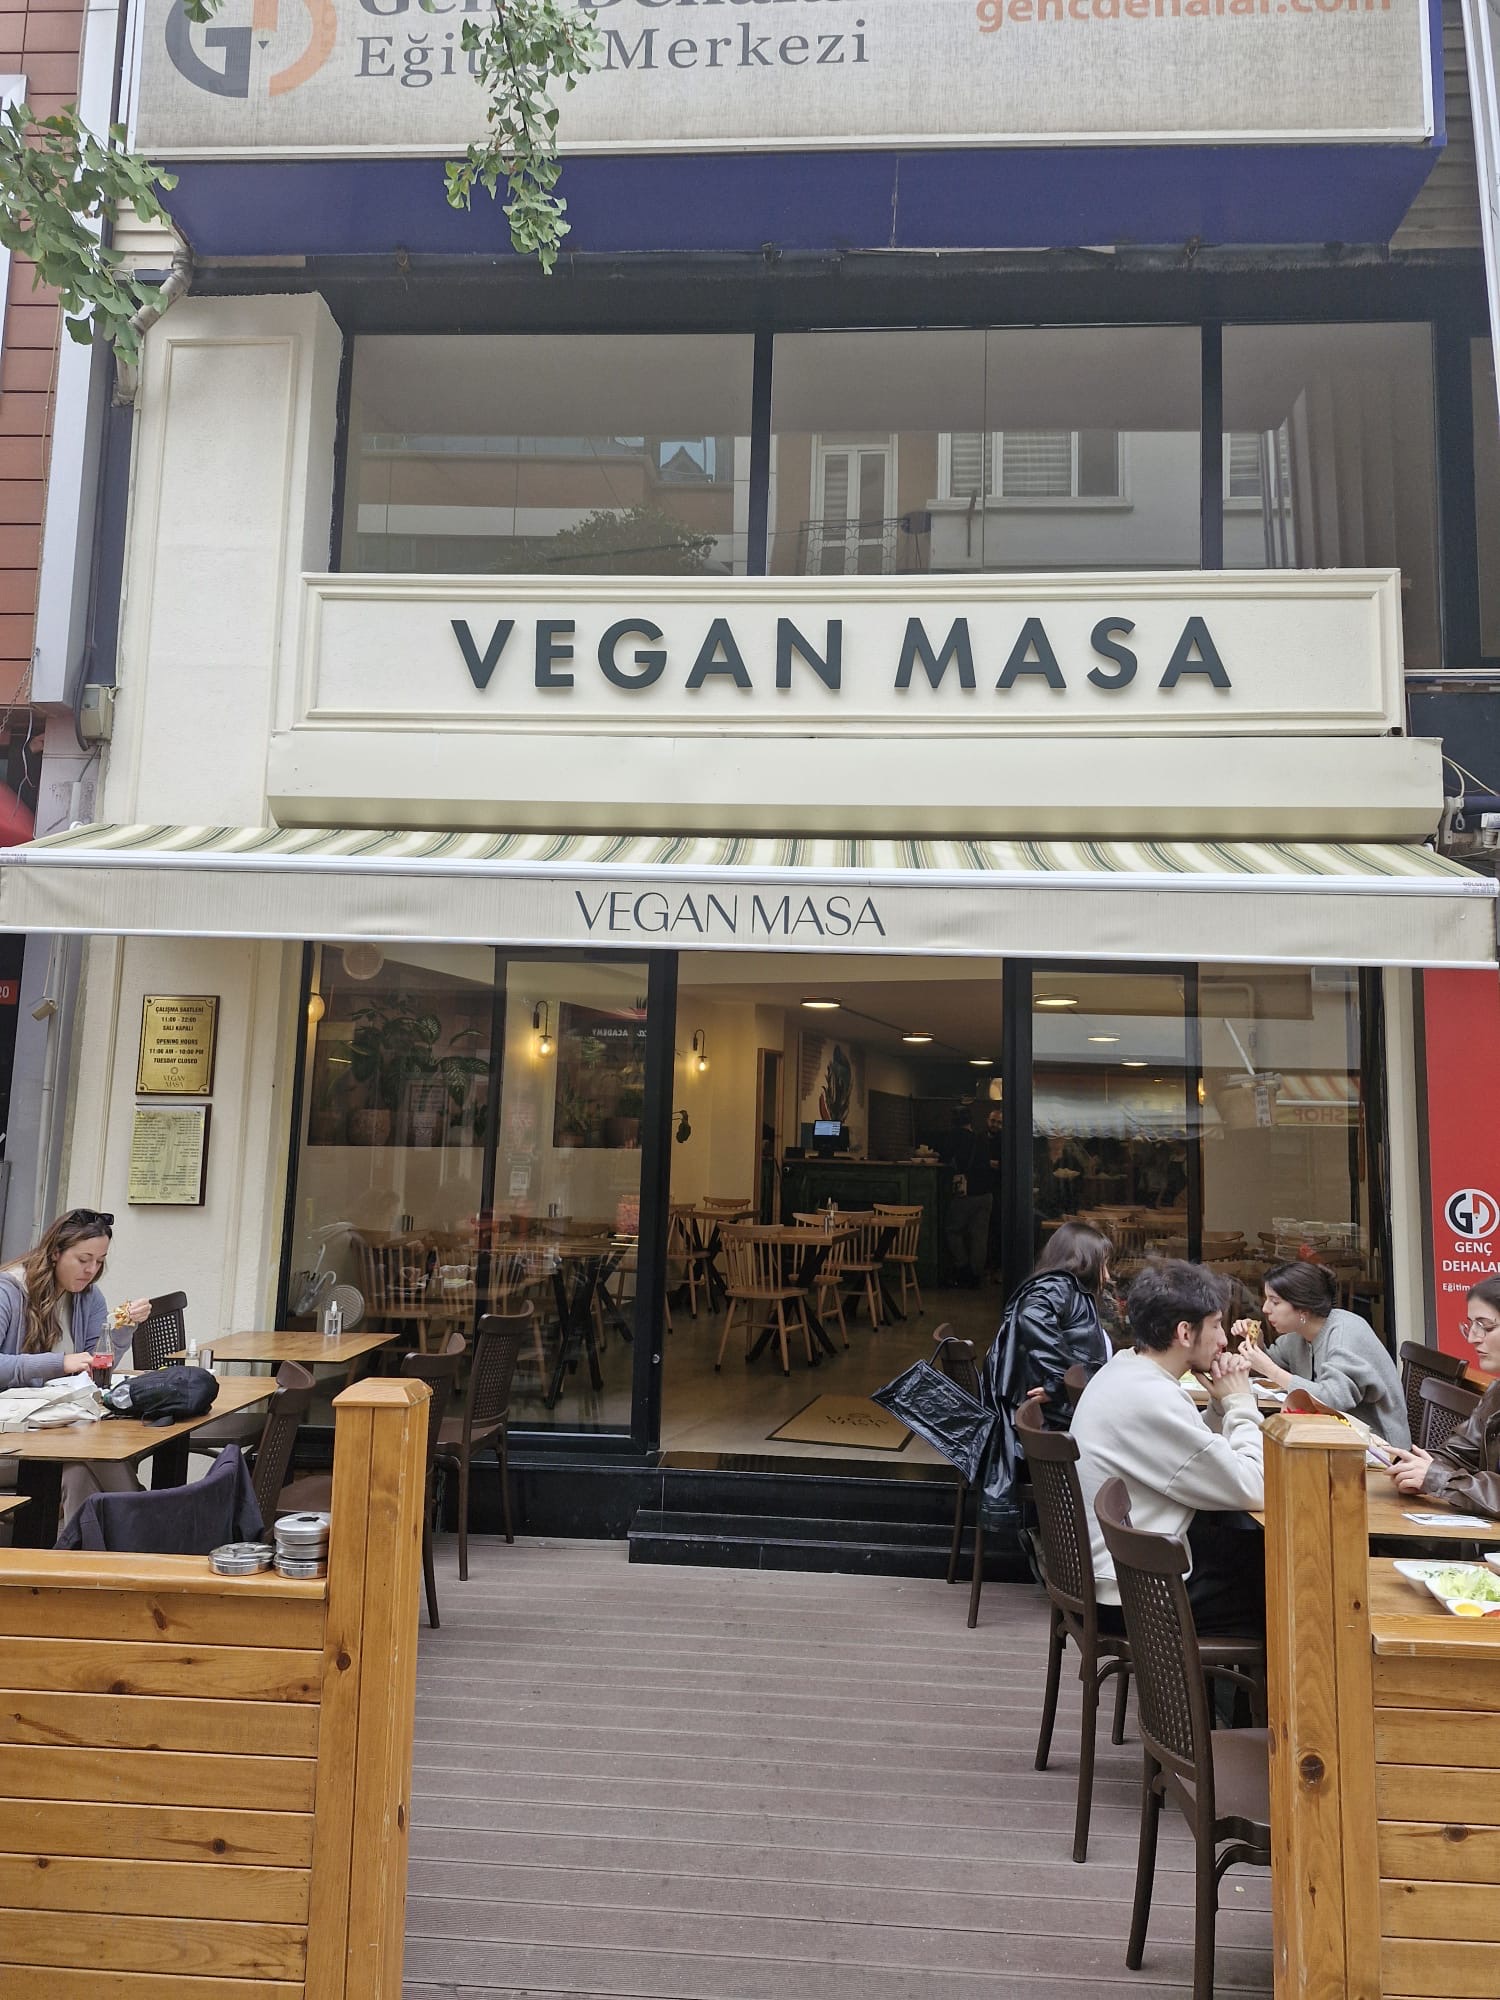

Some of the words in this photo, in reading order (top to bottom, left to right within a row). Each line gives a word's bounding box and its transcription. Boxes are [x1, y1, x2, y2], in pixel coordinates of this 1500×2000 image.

[354, 32, 560, 88] Eğit
[601, 19, 869, 71] Merkezi
[451, 617, 842, 691] VEGAN
[893, 616, 1232, 690] MASA
[575, 890, 738, 934] VEGAN
[752, 895, 887, 936] MASA
[1454, 1241, 1493, 1257] GENÇ
[1442, 1260, 1500, 1273] DEHALA
[1442, 1282, 1471, 1293] Eğitim
